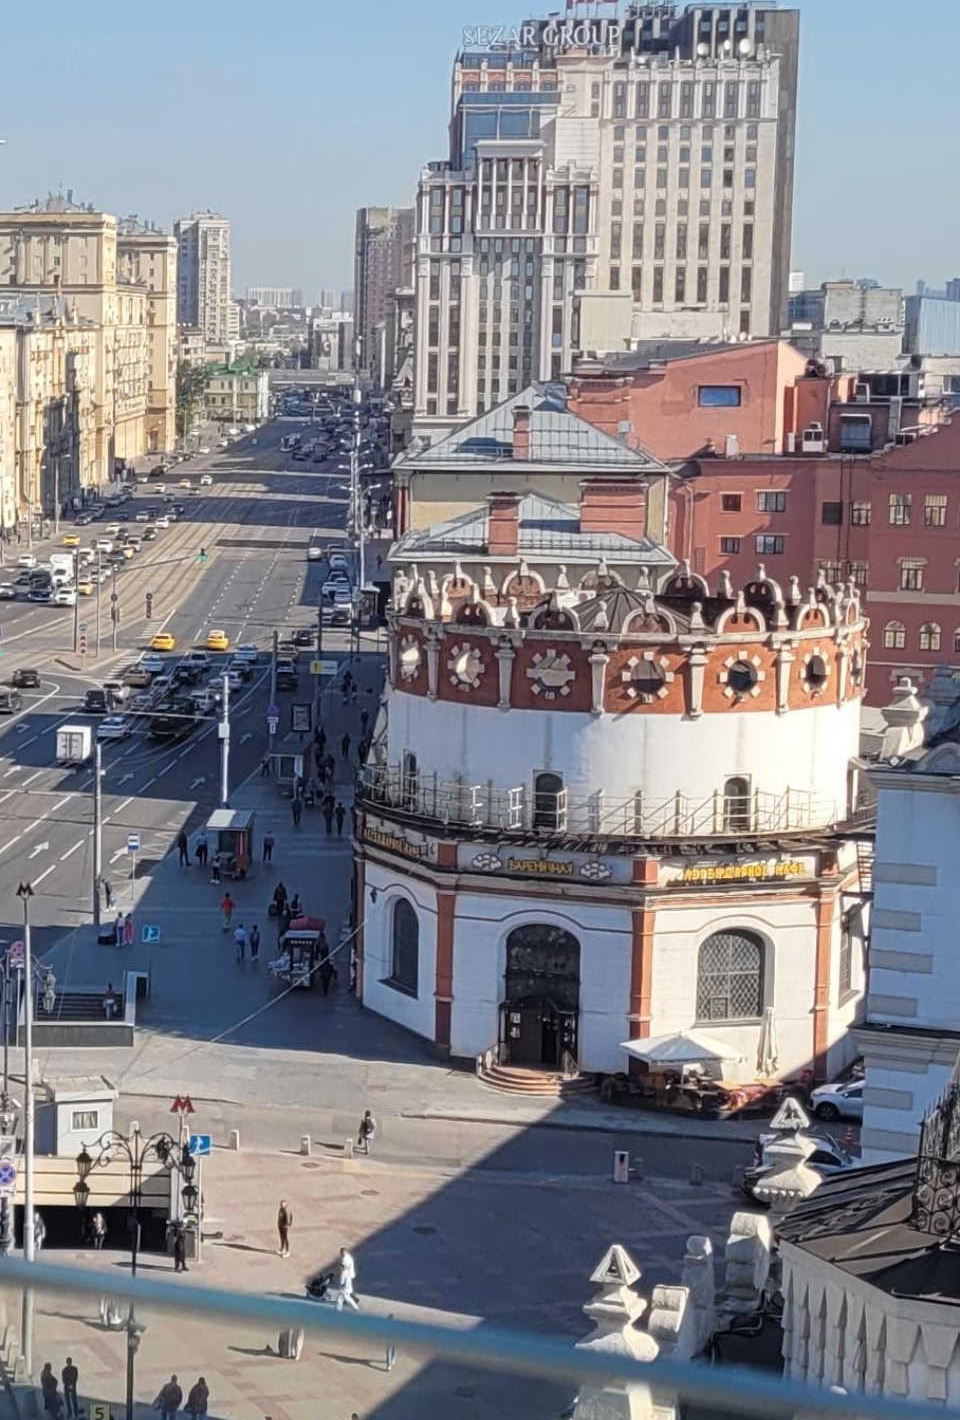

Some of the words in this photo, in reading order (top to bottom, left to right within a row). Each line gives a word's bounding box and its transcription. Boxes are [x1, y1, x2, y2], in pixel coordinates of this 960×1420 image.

[463, 26, 535, 46] SEZAR
[542, 25, 620, 46] GROUP
[508, 859, 574, 875] ВАРЕНИЧНАЯ
[95, 1407, 105, 1420] 5
